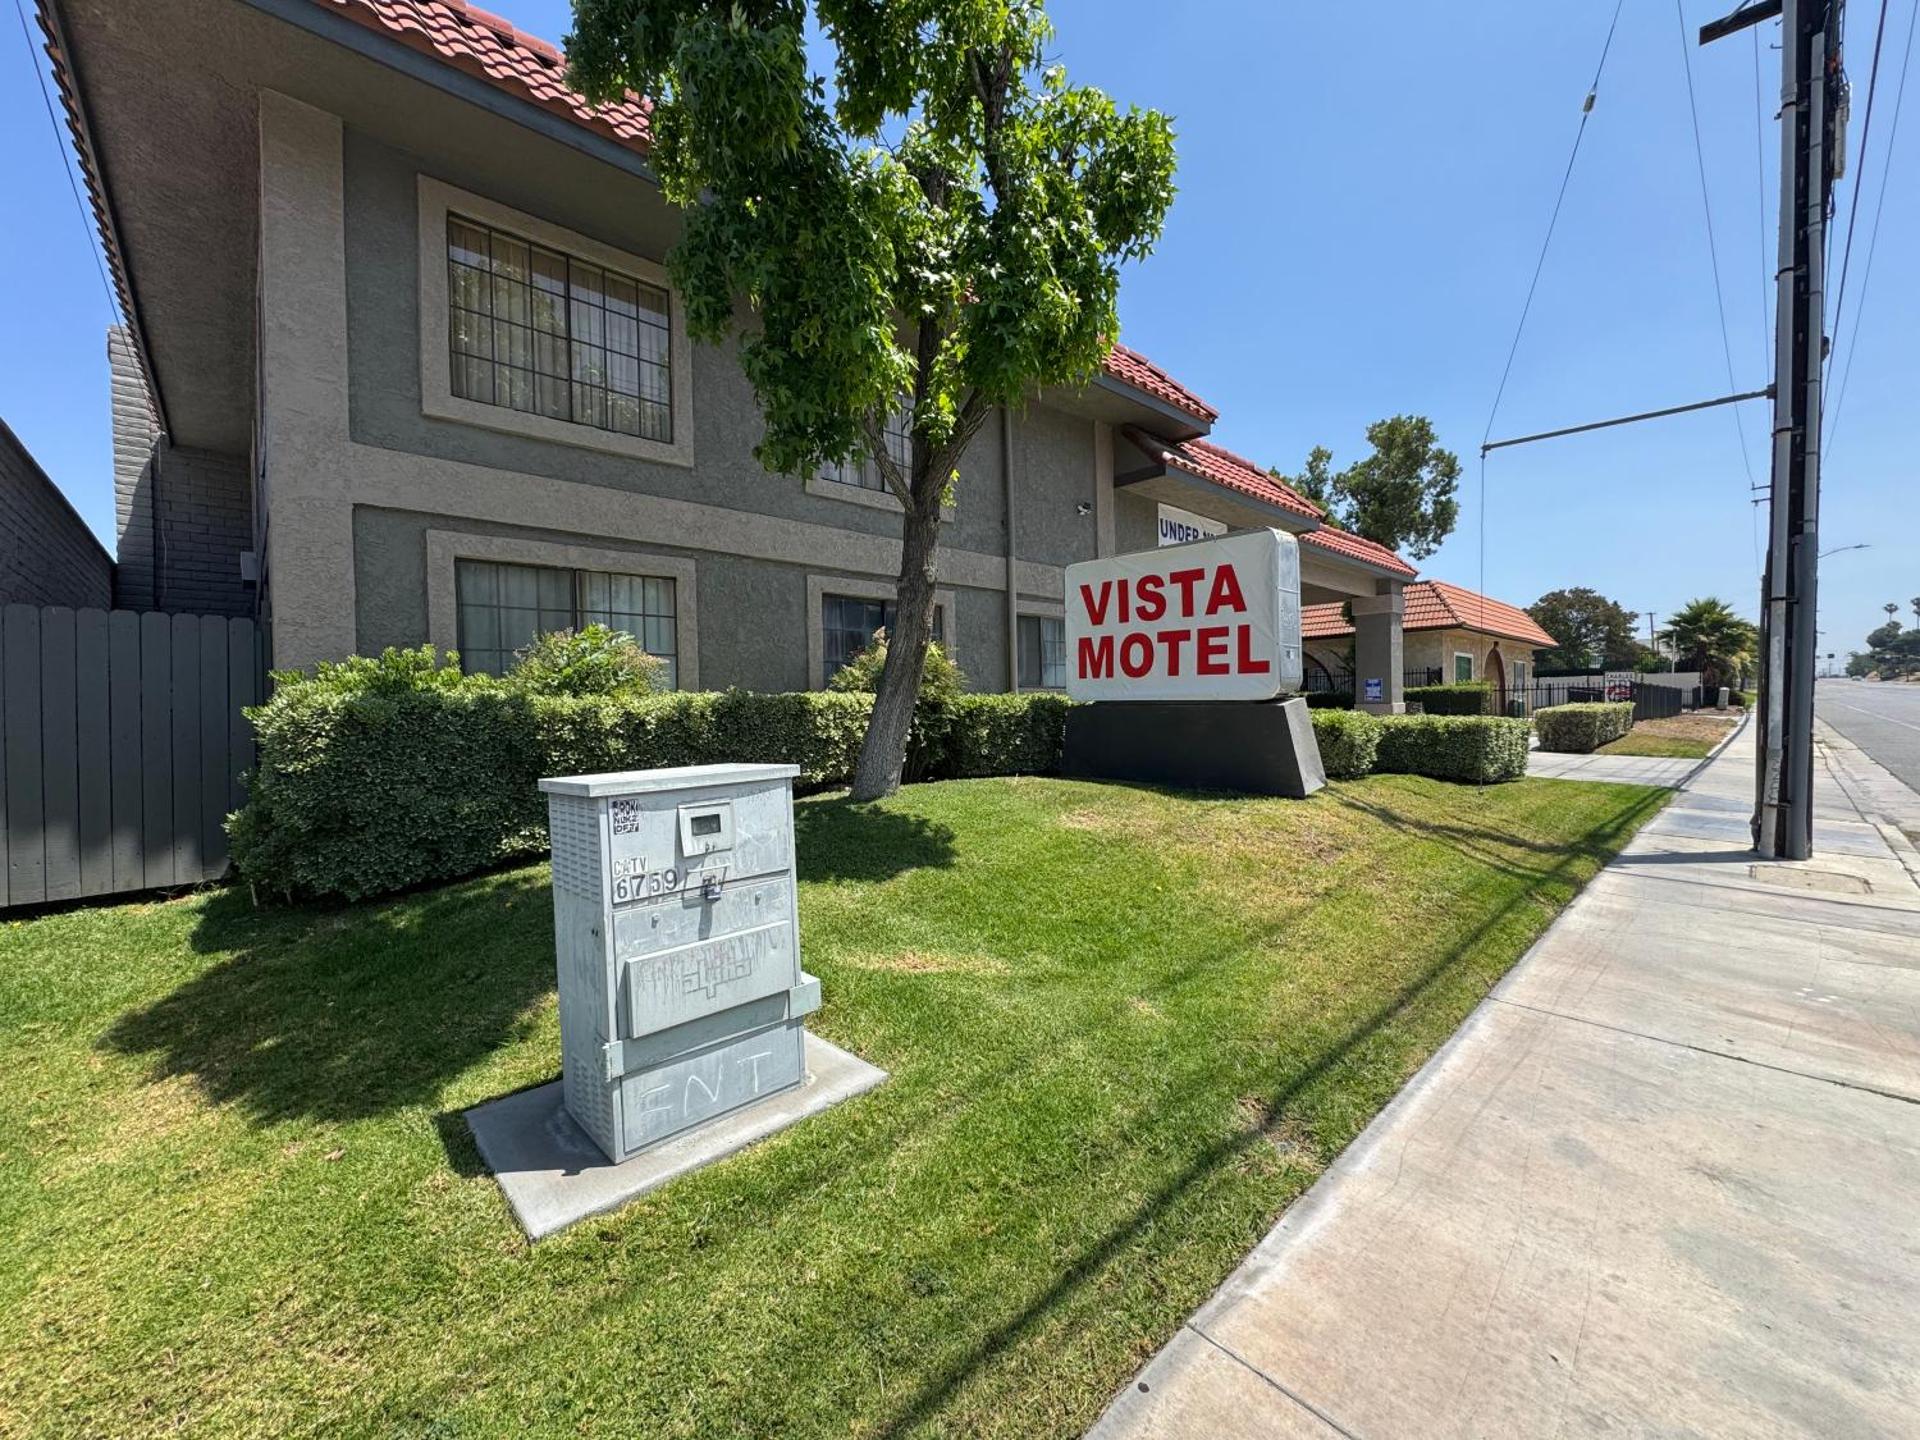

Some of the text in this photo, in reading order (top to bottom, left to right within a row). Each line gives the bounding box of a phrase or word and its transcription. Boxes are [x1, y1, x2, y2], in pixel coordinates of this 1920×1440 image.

[1159, 518, 1199, 542] UNDER
[1080, 563, 1248, 626] VISTA
[1077, 624, 1271, 679] MOTEL
[613, 856, 646, 876] CATV
[616, 868, 678, 900] 6759
